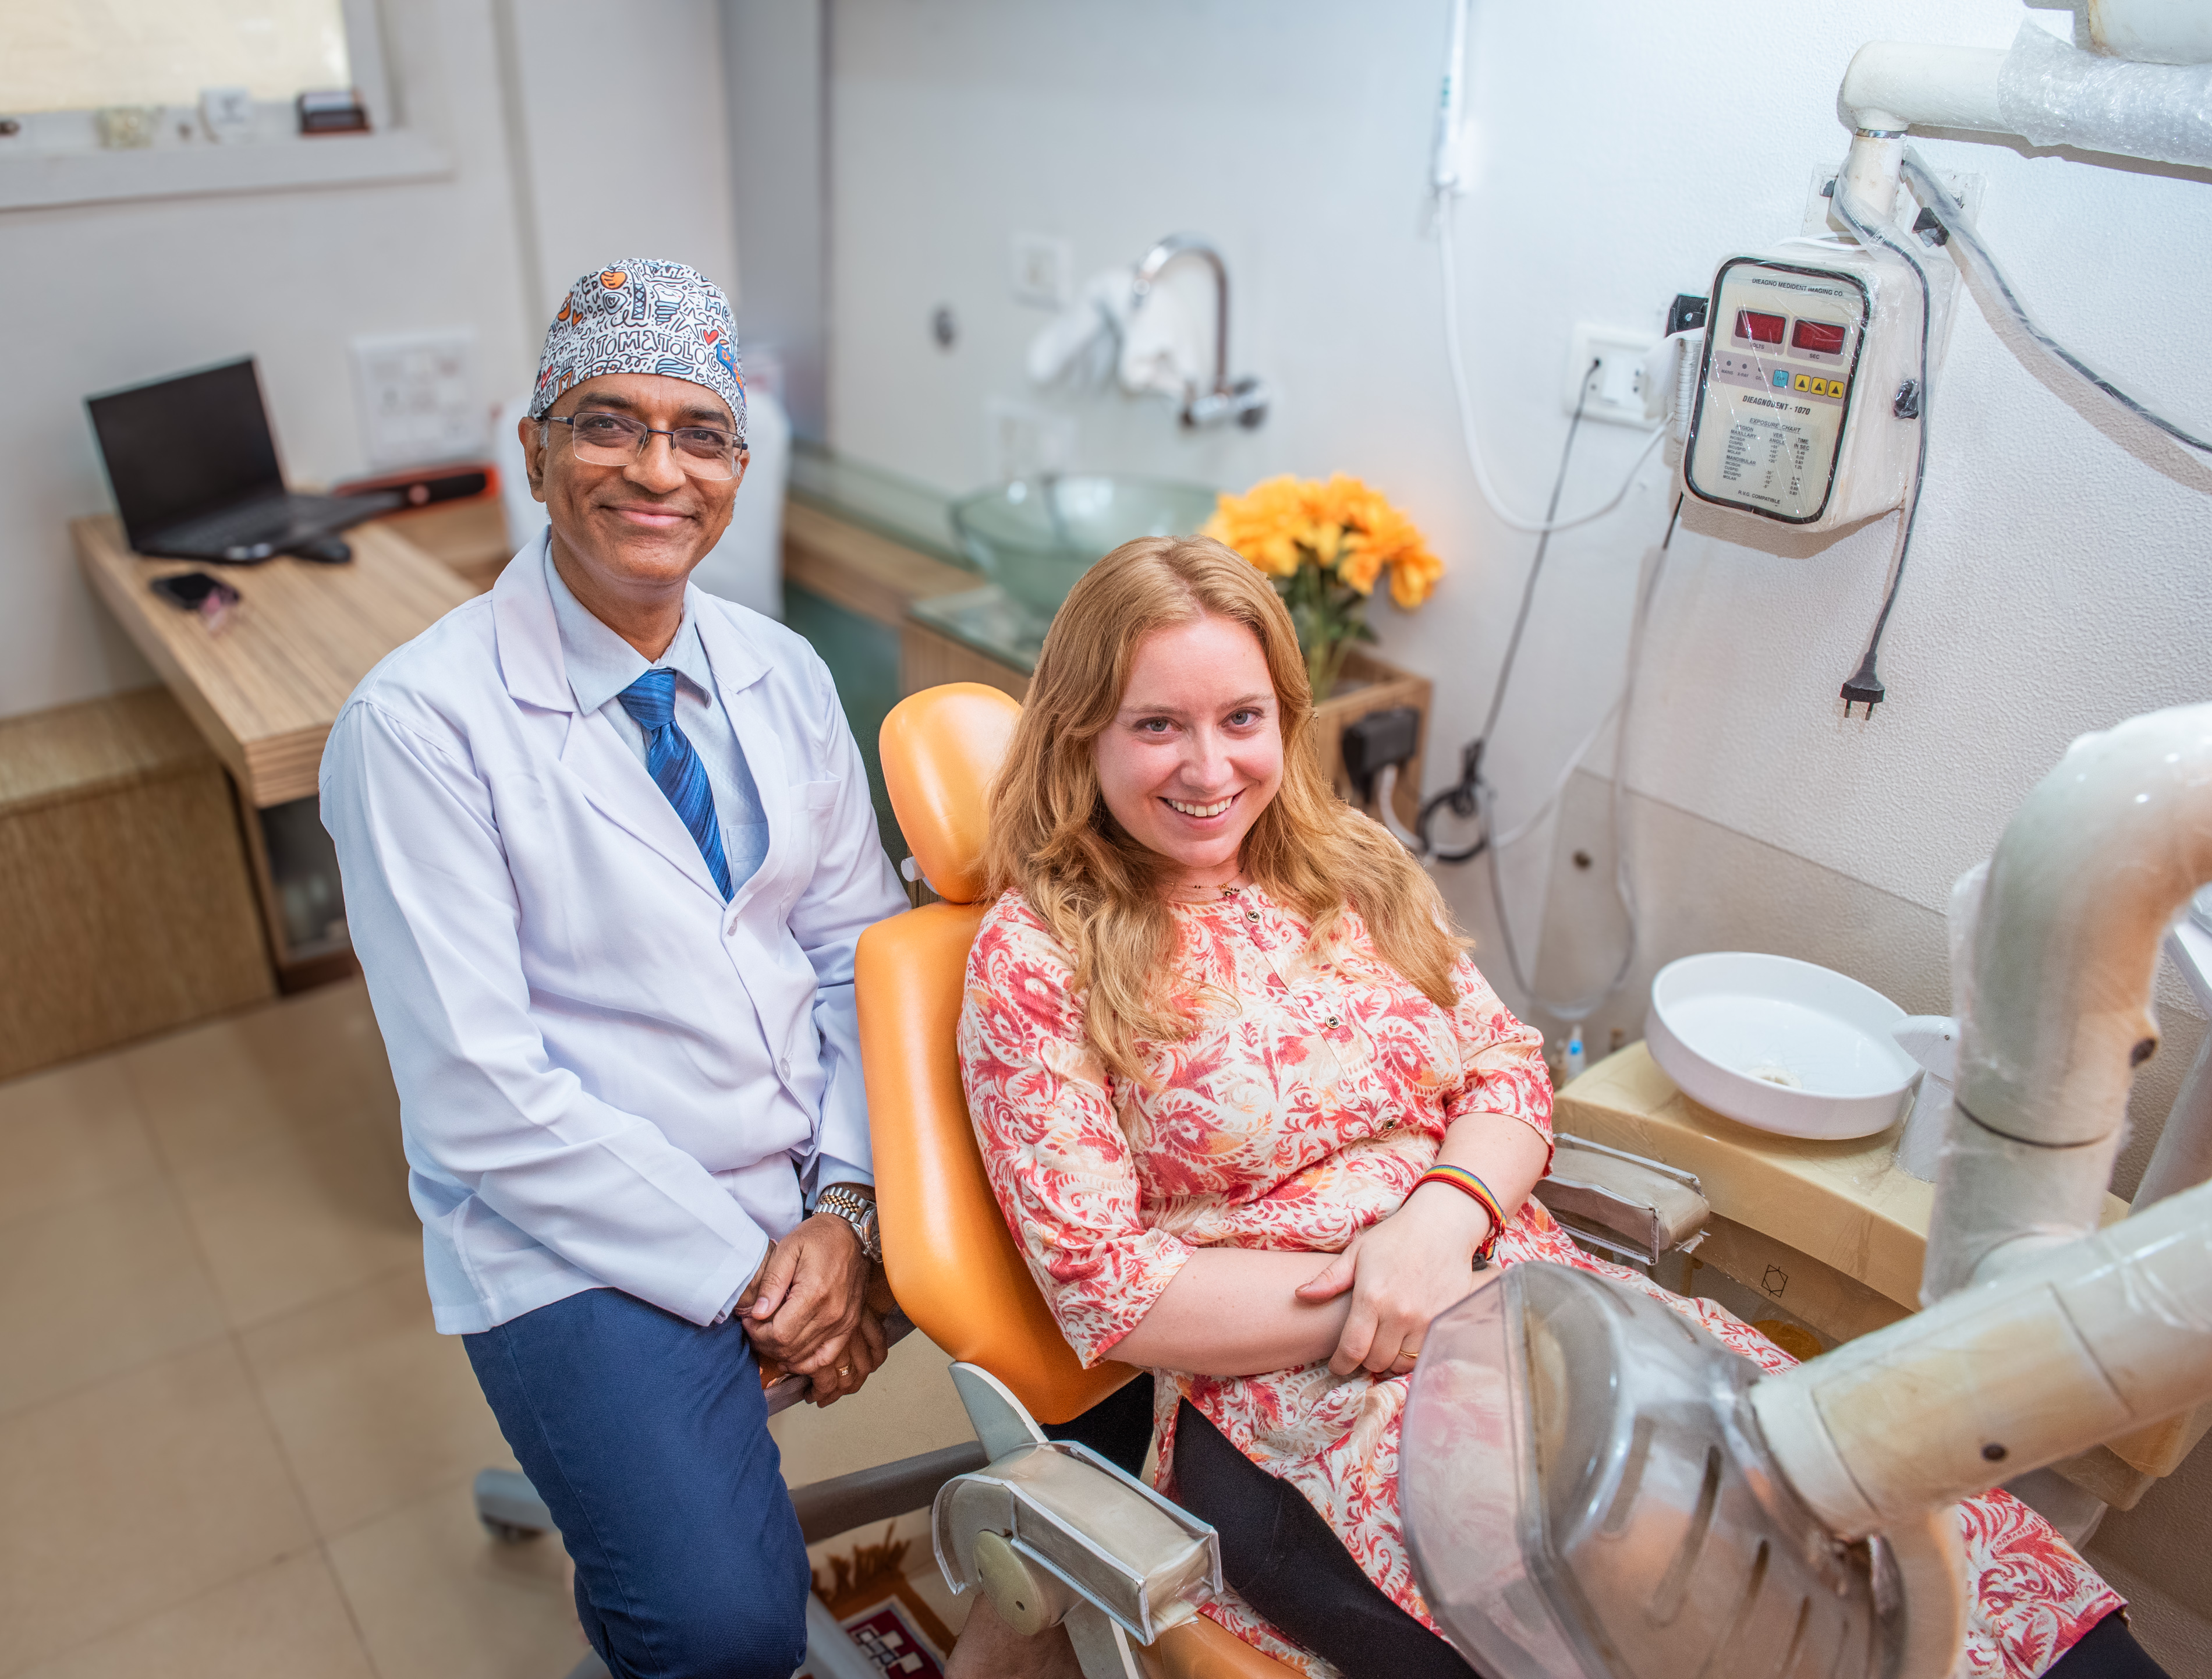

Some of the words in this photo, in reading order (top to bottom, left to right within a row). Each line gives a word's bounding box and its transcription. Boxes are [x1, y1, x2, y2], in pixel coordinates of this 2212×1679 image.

[1752, 278, 1777, 286] DIEAGNO
[1778, 282, 1807, 291] MEDIDENT
[1807, 287, 1832, 295] IMAGING
[1742, 395, 1789, 410] DIEAGNODENT
[1795, 406, 1811, 415] 1070
[1749, 417, 1779, 428] EXPOSURE
[1782, 424, 1801, 433] CHART
[1731, 429, 1757, 438] MAXILLARY
[1726, 455, 1756, 465] MANDIBULAR
[1752, 493, 1781, 504] COMPATIBLE
